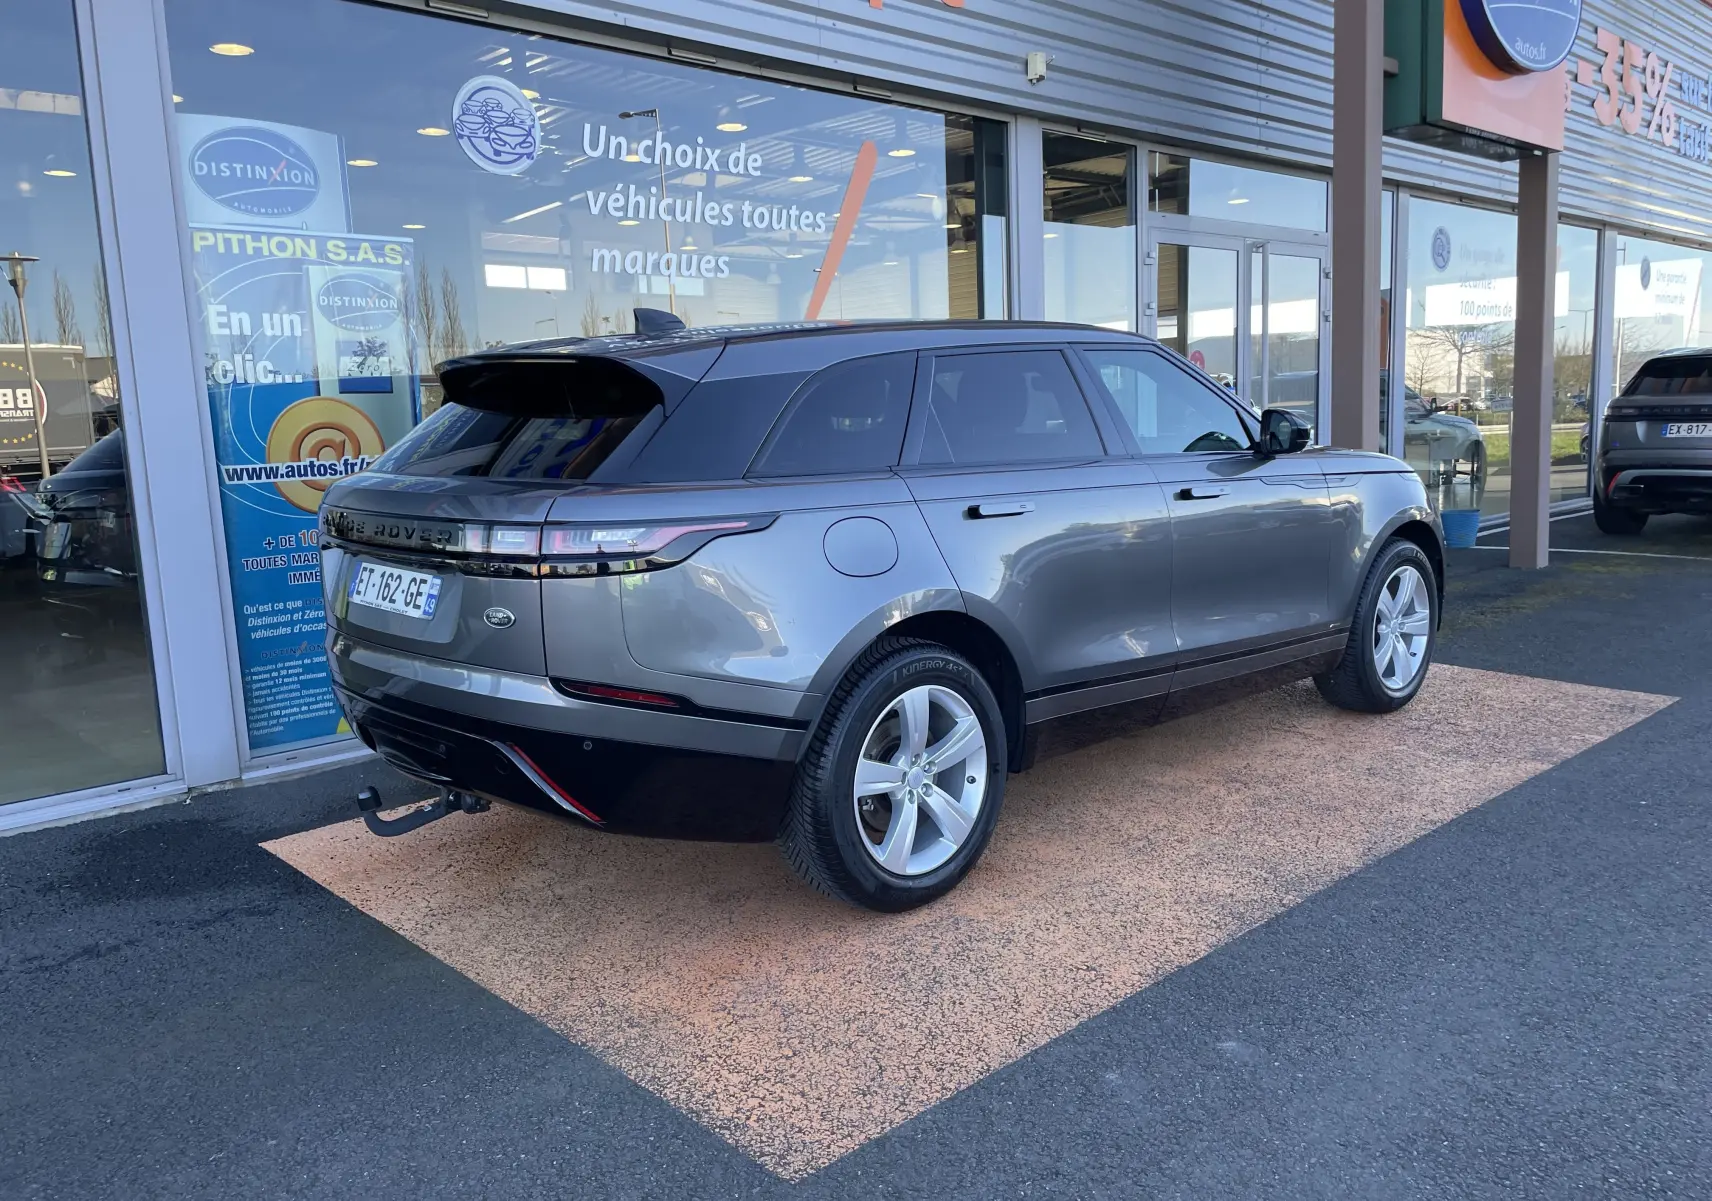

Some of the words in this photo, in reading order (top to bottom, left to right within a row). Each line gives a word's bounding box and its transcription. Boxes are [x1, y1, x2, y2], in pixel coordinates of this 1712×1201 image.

[1515, 37, 1546, 60] autos.fr
[583, 122, 628, 160] Un
[637, 131, 720, 172] choix
[728, 142, 763, 177] de
[194, 159, 316, 187] DISTINXION
[233, 201, 293, 214] AUTOMOBILE
[586, 183, 734, 228] véhicules
[742, 200, 826, 234] toutes
[193, 230, 318, 260] PITHON
[326, 239, 412, 267] S.A.S.
[591, 247, 730, 285] marques
[319, 294, 398, 310] DISTINXION
[1460, 300, 1475, 316] 100
[1476, 300, 1502, 320] points
[1503, 302, 1513, 317] de
[207, 303, 251, 336] En
[262, 311, 302, 337] un
[213, 352, 303, 385] clic...
[280, 535, 296, 548] DE
[374, 523, 453, 544] ROVER
[243, 554, 287, 571] TOUTES
[356, 566, 428, 611] ET-162-GE
[243, 602, 272, 615] Qu'est
[274, 602, 285, 611] ce
[286, 600, 303, 611] que
[425, 597, 436, 614] 49
[247, 613, 291, 628] Distinxion
[292, 611, 302, 621] et
[250, 624, 292, 640] véhicules
[902, 660, 945, 677] KINERGY
